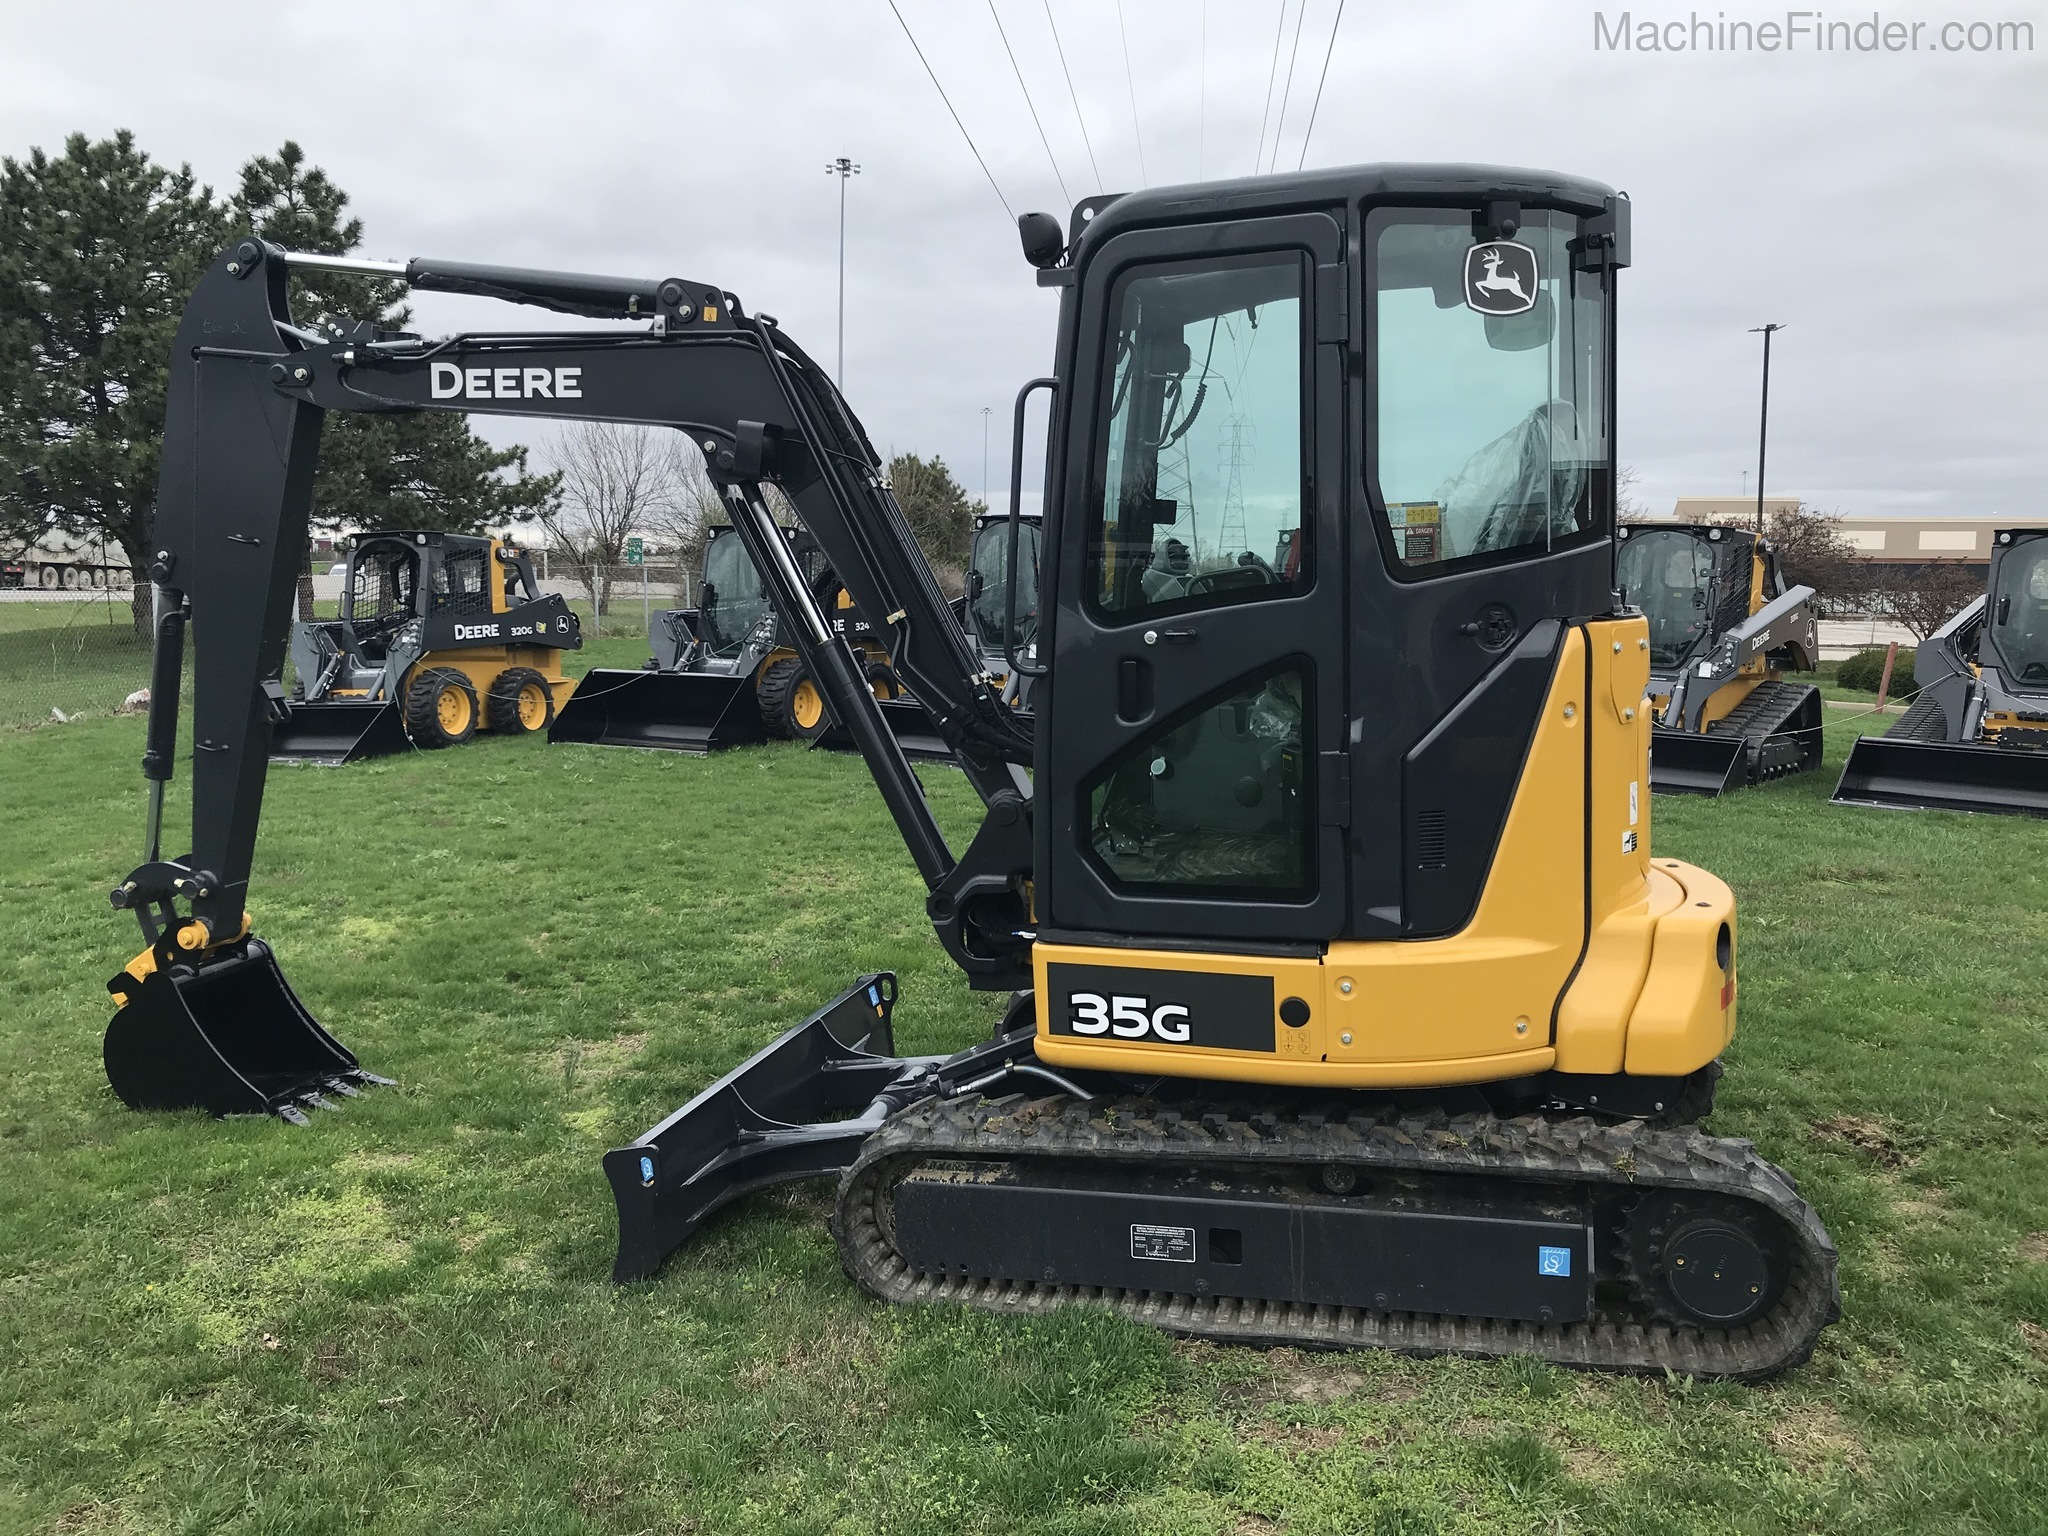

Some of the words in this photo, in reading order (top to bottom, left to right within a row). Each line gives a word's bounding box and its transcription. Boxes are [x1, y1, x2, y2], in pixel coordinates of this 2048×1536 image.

[430, 362, 583, 399] DEERE
[454, 623, 500, 641] DEERE
[510, 626, 533, 637] 320G
[1752, 629, 1771, 651] DEERE
[1071, 993, 1190, 1042] 35G
